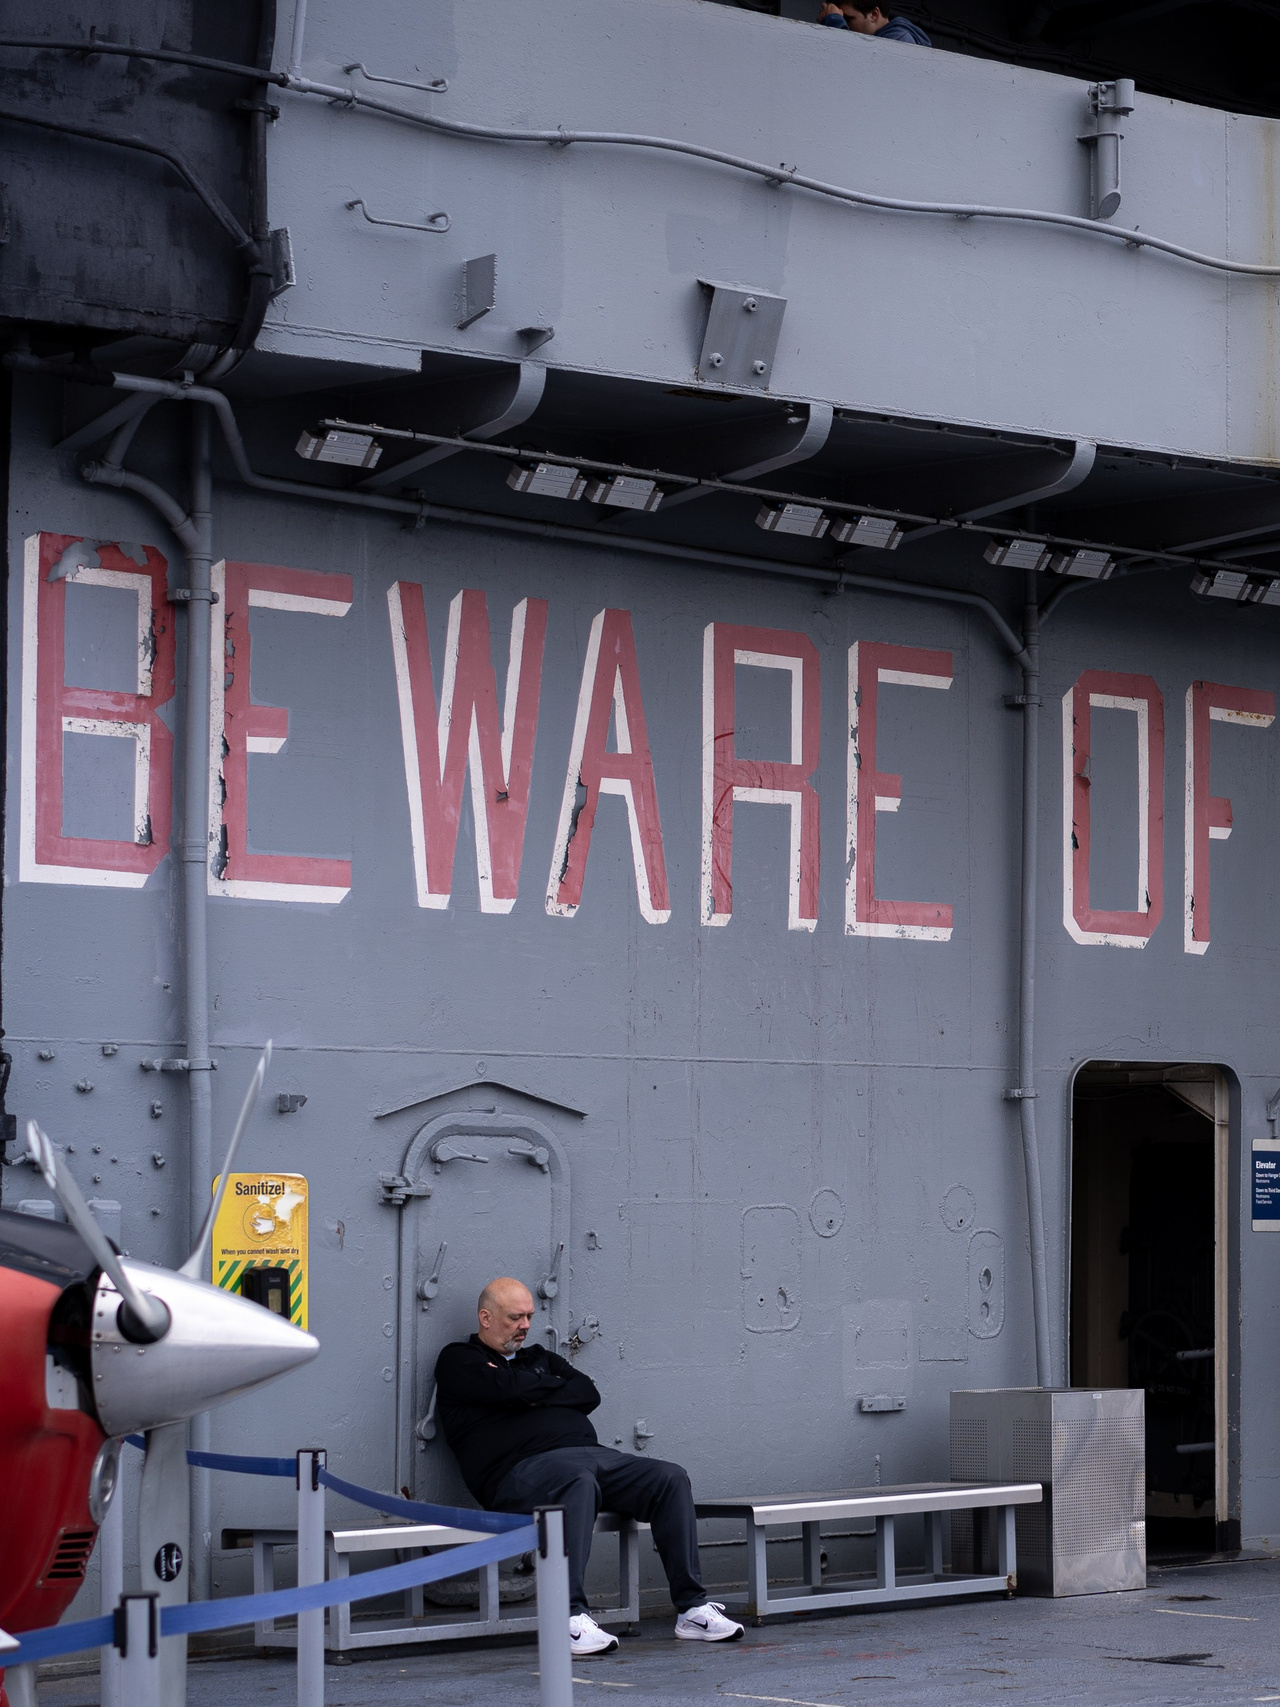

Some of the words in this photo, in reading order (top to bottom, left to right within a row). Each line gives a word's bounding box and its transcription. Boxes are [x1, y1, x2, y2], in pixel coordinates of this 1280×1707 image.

[19, 531, 954, 942] BEWARE
[1062, 669, 1276, 956] OF
[1256, 1161, 1276, 1169] Elevator
[235, 1181, 285, 1196] Sanitize!
